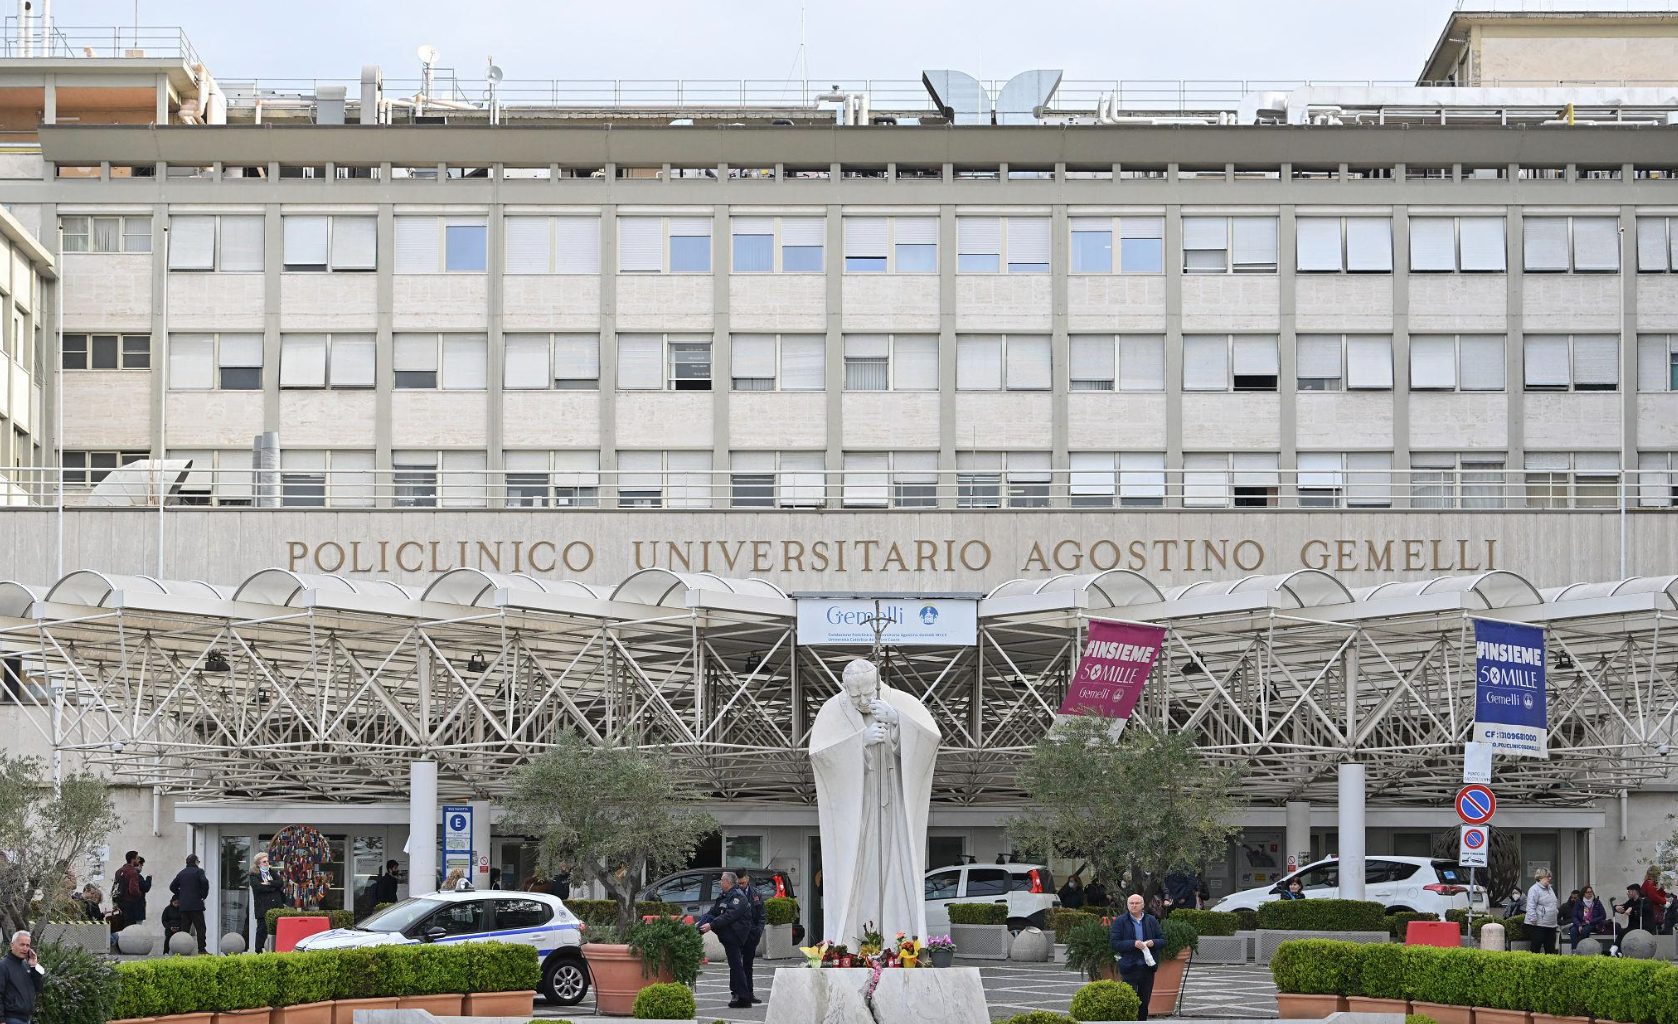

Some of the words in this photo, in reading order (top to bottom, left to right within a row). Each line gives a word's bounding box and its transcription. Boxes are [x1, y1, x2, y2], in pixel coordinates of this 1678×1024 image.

[286, 541, 595, 573] POLICLINICO
[632, 540, 992, 572] UNIVERSITARIO
[1021, 540, 1265, 572] AGOSTINO
[1300, 539, 1498, 572] GEMELLI
[1083, 640, 1154, 663] #INSIEME
[1476, 641, 1541, 666] #INSIEME
[1079, 687, 1110, 699] Gemelli
[1486, 692, 1519, 705] Gemelli
[456, 819, 461, 827] E
